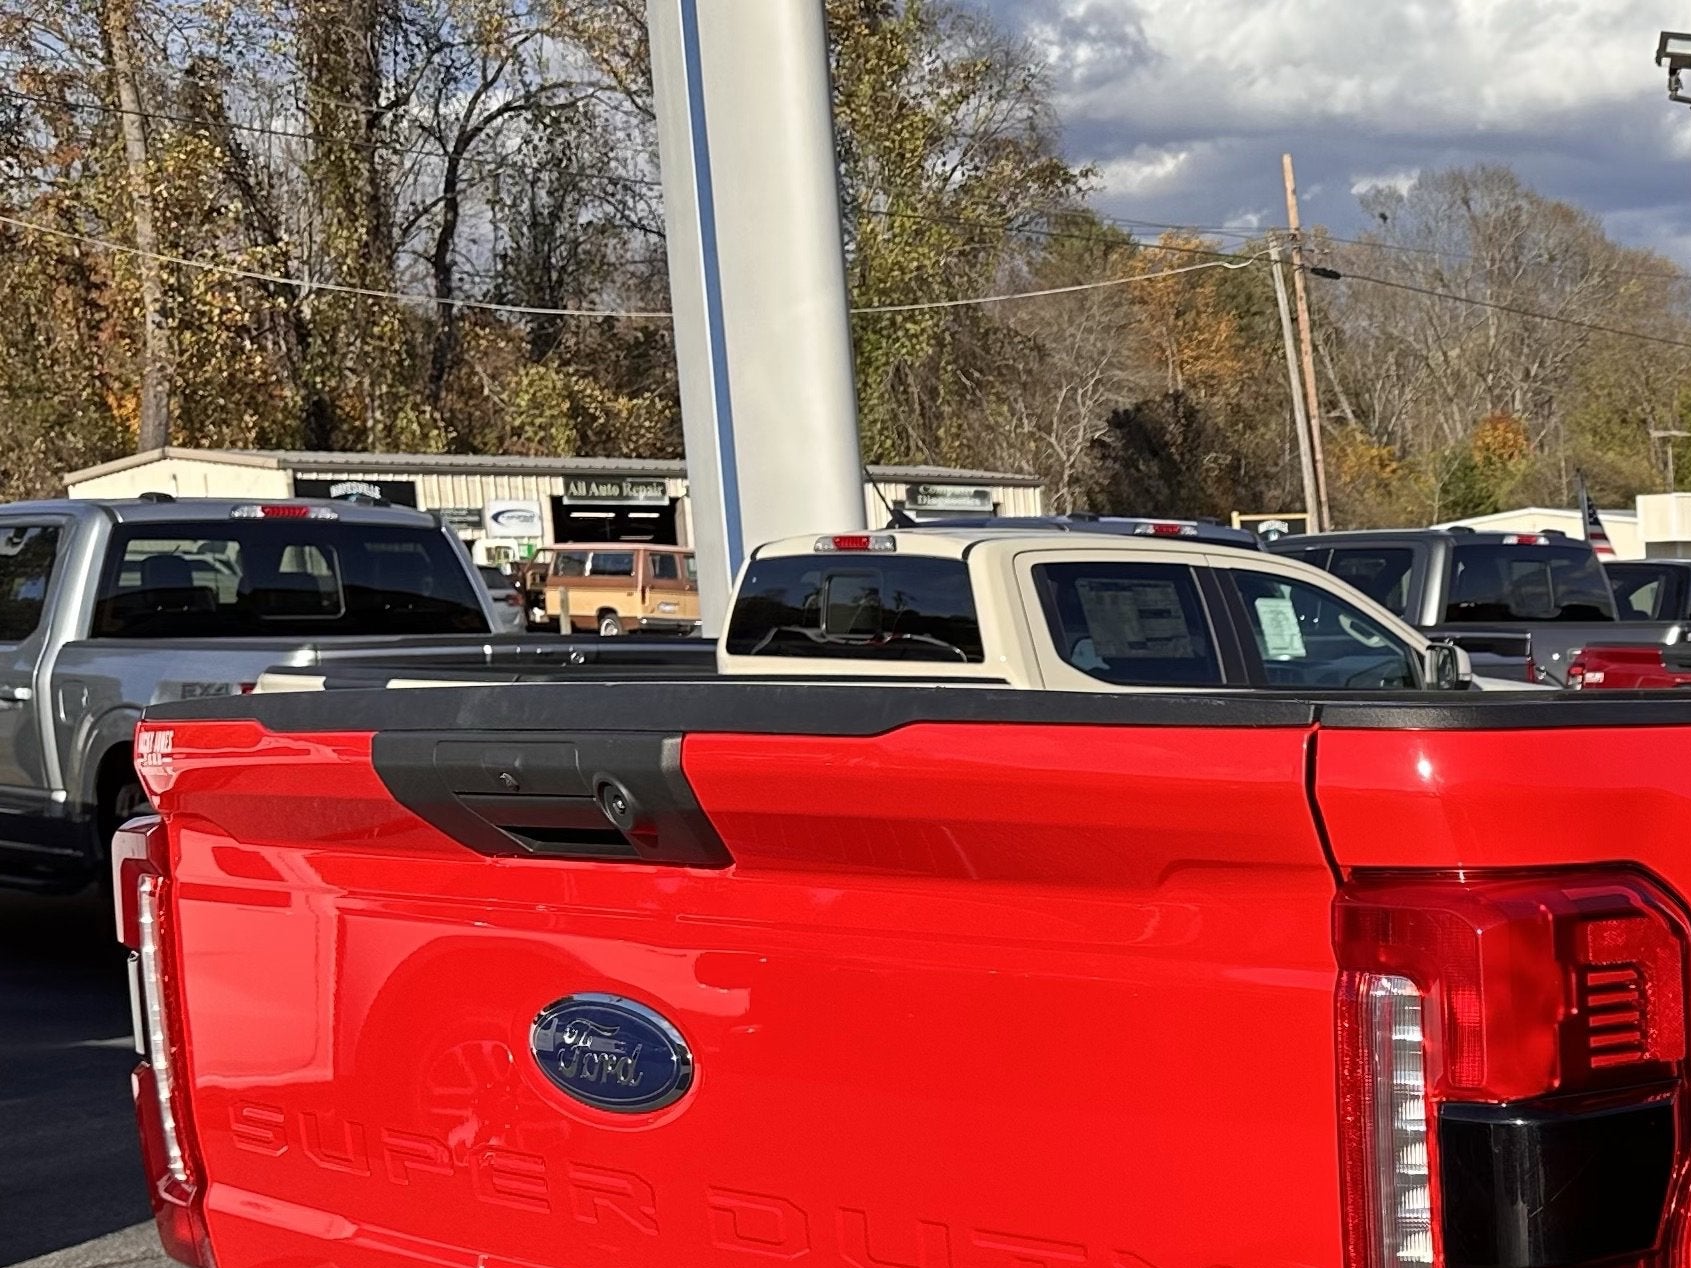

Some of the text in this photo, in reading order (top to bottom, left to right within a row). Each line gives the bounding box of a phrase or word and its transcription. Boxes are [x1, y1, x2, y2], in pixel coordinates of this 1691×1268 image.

[567, 480, 665, 500] All Auto Repair
[557, 1017, 645, 1087] Ford
[228, 1101, 660, 1236] SUPER
